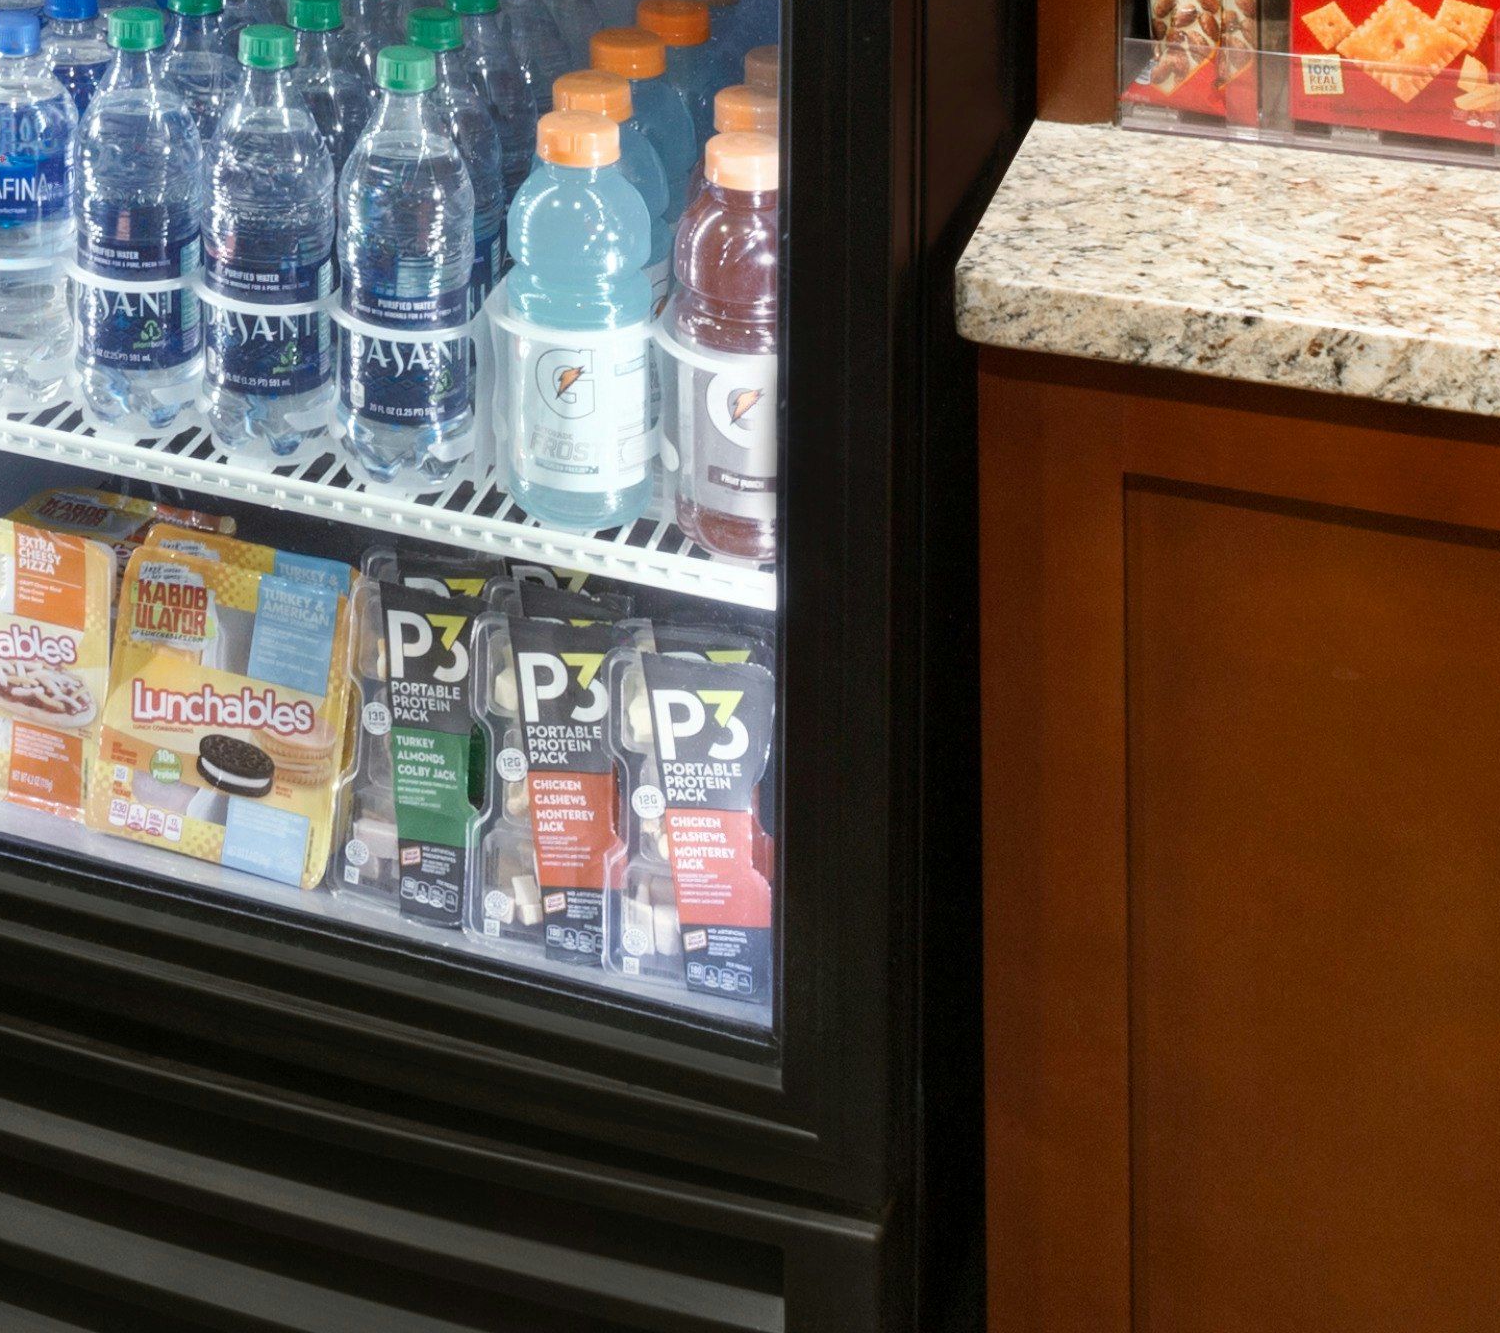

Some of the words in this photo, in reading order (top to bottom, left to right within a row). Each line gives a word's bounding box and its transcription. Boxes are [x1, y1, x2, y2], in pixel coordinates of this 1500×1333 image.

[378, 299, 412, 310] PURIFIED
[413, 301, 437, 310] WATER
[535, 348, 596, 419] G
[18, 534, 55, 551] EXTRA
[19, 547, 61, 565] CHEESY
[19, 558, 55, 575] PIZZA
[138, 579, 208, 611] KABOB
[264, 587, 313, 606] TURKEY
[314, 601, 325, 613] &
[136, 604, 206, 636] ULATOR
[264, 602, 330, 626] AMERICAN
[387, 610, 470, 683] P3
[391, 682, 461, 701] PORTABLE
[517, 652, 610, 723] P3
[133, 679, 314, 735] Lunchables
[392, 695, 451, 712] PROTEIN
[394, 709, 429, 723] PACK
[652, 689, 750, 761] P3
[527, 726, 602, 740] PORTABLE
[396, 735, 435, 750] TURKEY
[528, 739, 592, 753] PROTEIN
[397, 750, 445, 765] ALMONDS
[530, 751, 569, 764] PACK
[398, 764, 431, 778] COLBY
[432, 769, 457, 781] JACK
[663, 762, 742, 777] PORTABLE
[533, 780, 581, 791] CHICKEN
[665, 776, 732, 790] PROTEIN
[535, 794, 587, 807] CASHEWS
[667, 789, 707, 803] PACK
[536, 810, 595, 821] MONTEREY
[671, 816, 722, 829] CHICKEN
[538, 821, 565, 833] JACK
[673, 832, 726, 844] CASHEWS
[674, 846, 735, 859] MONTEREY
[676, 858, 705, 870] JACK
